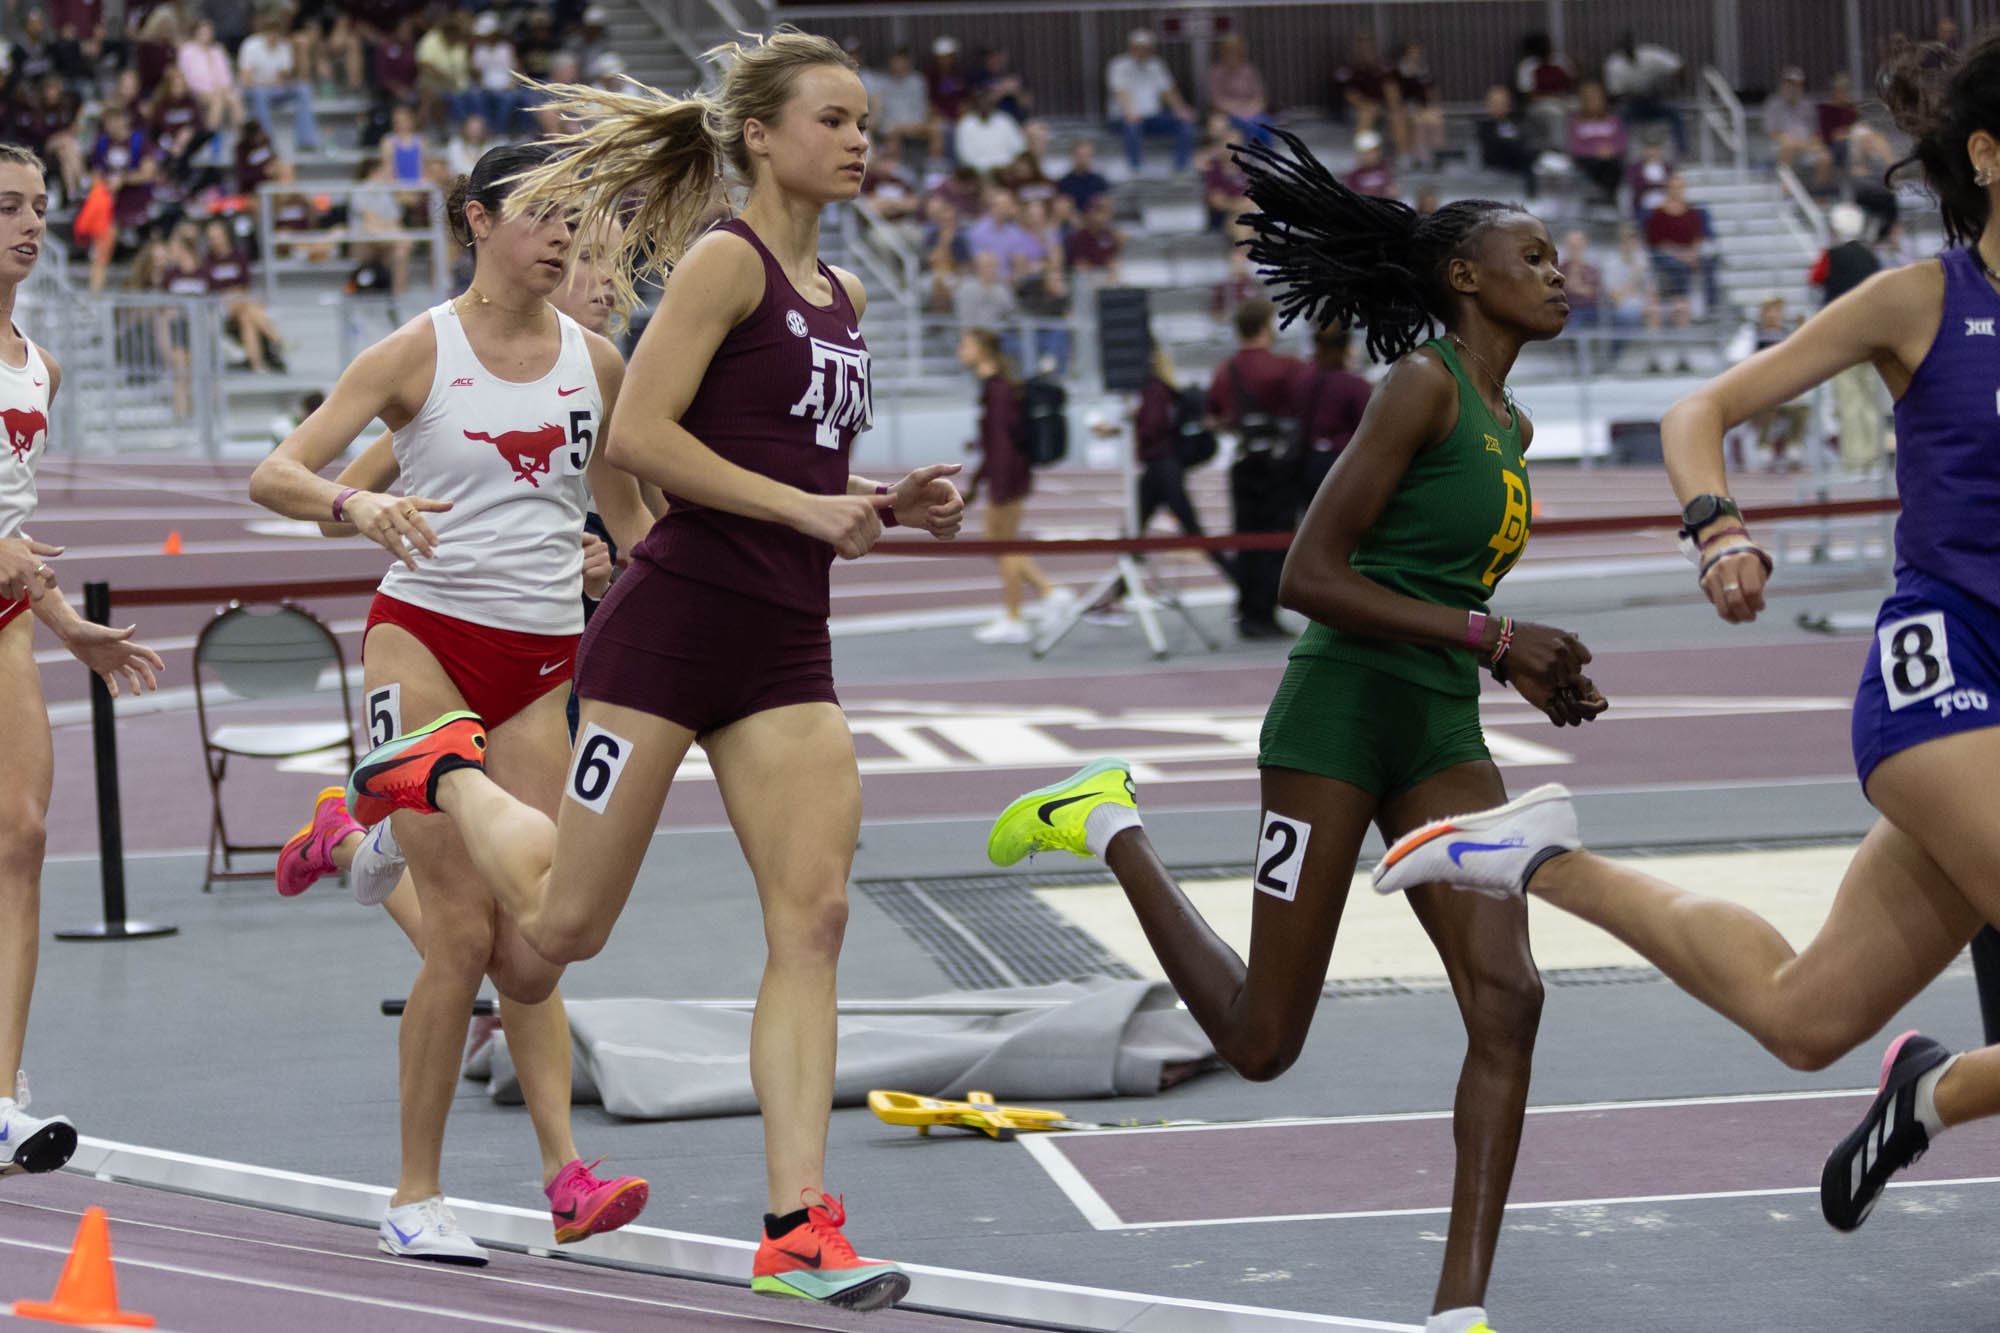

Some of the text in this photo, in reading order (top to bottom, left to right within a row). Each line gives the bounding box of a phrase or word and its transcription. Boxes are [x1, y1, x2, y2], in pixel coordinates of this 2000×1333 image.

[451, 378, 474, 386] ACC
[569, 411, 593, 470] 5
[1892, 624, 1940, 696] 8
[371, 690, 393, 748] 5
[1934, 688, 1988, 718] TCU
[575, 734, 620, 801] 6
[1258, 821, 1297, 893] 2
